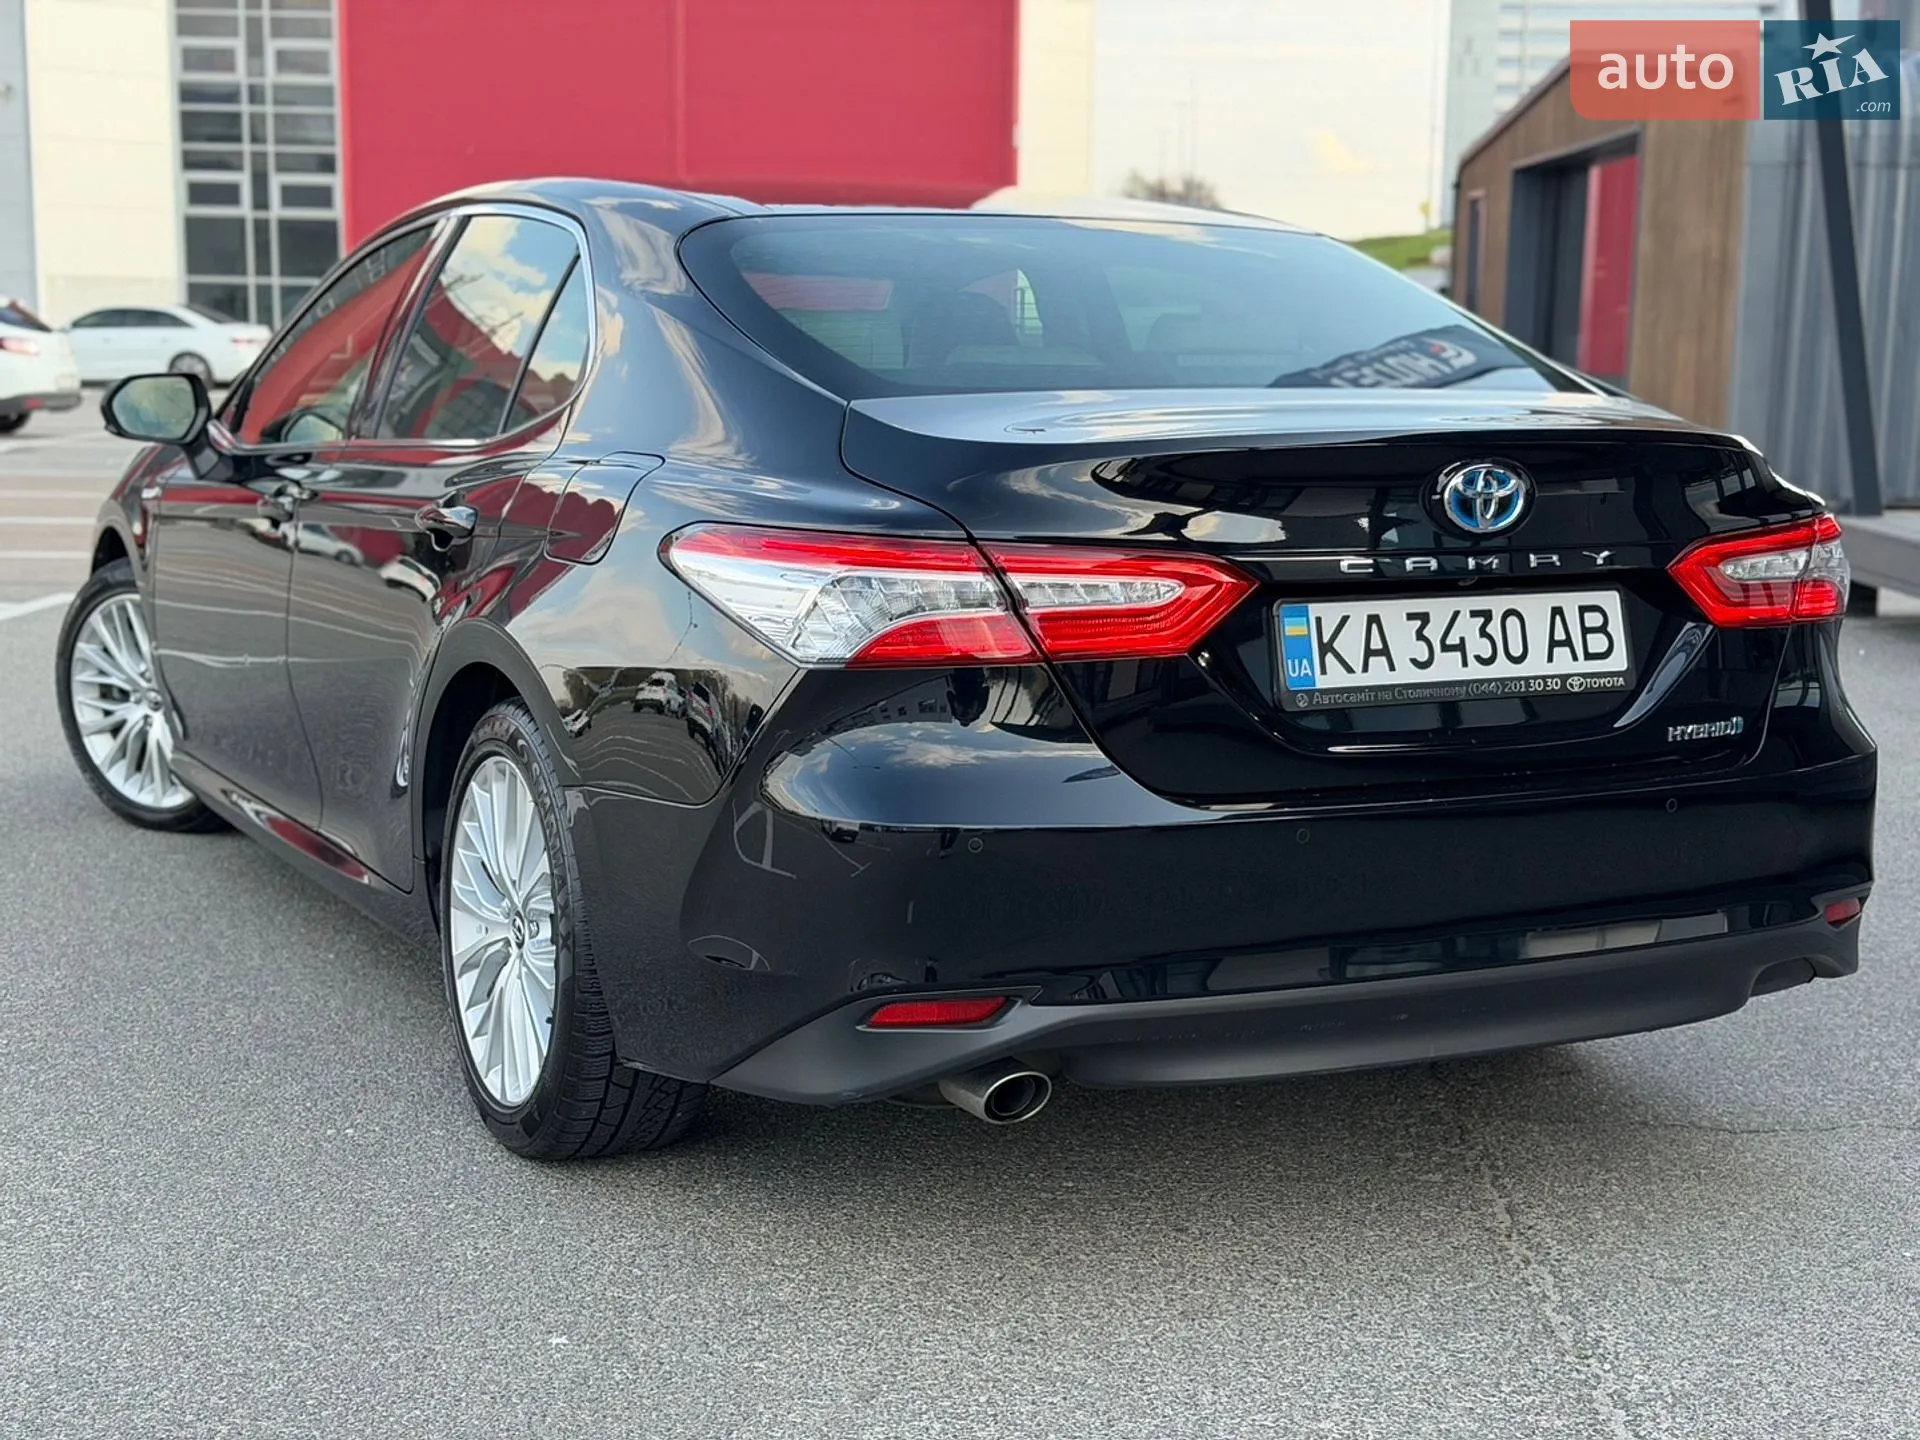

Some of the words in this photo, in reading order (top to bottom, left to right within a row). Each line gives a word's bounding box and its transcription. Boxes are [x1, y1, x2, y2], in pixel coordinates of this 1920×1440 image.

[1339, 550, 1615, 574] CAMRY
[1315, 613, 1396, 676] KA
[1405, 607, 1529, 670] 3430
[1546, 604, 1615, 664] AB
[1287, 657, 1312, 678] UA
[1468, 681, 1503, 697] (044)
[1504, 680, 1526, 692] 201
[1528, 679, 1543, 691] 30
[1545, 678, 1561, 690] 30
[1586, 676, 1625, 688] TOYOTA
[1667, 721, 1732, 742] HYBRID
